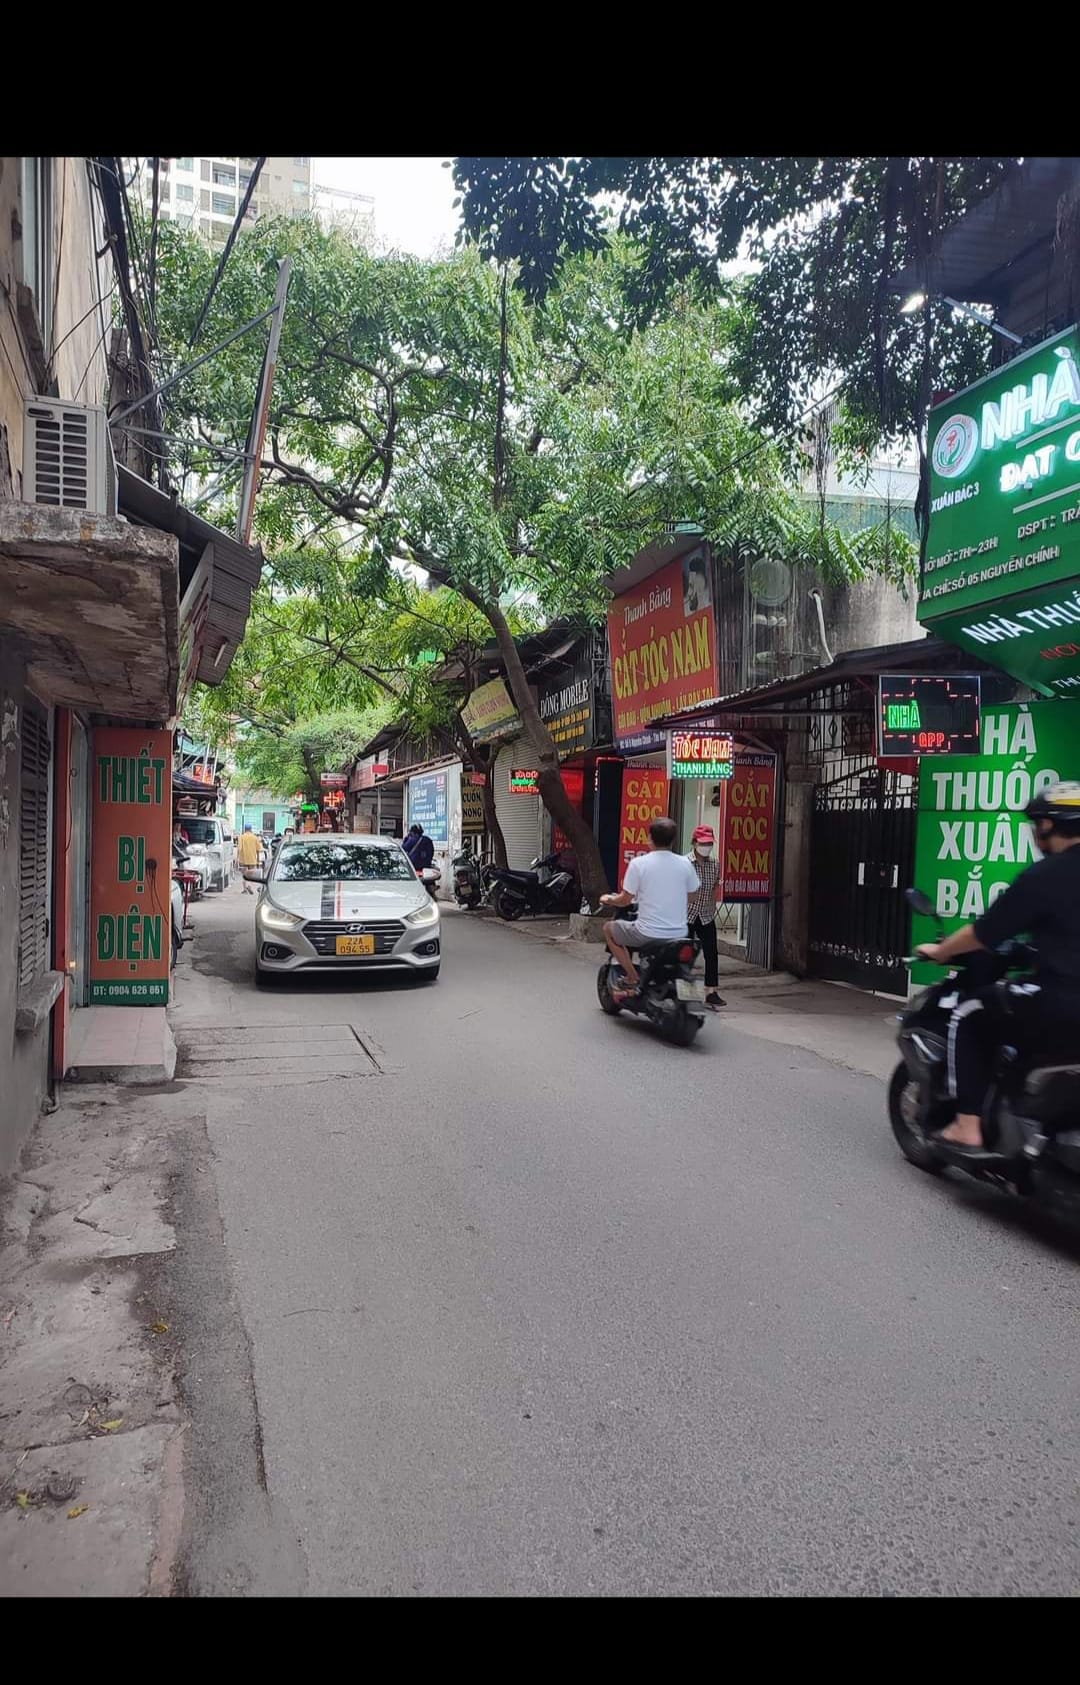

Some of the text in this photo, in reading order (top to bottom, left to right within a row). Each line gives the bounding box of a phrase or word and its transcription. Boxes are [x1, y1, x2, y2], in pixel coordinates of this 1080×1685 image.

[981, 346, 1080, 450] NHÀ
[1000, 444, 1055, 492] ĐẠT
[1025, 545, 1060, 567] CHÍNH
[961, 613, 1034, 644] NHÀ
[614, 616, 711, 699] CẮT TÓC NAM
[560, 679, 589, 711] MOBILE
[888, 700, 921, 729] NHÀ
[983, 704, 1037, 755] HÀ
[96, 742, 165, 806] THIẾT
[675, 762, 704, 774] THANH
[627, 772, 664, 798] CẮT
[731, 771, 769, 807] CẮT
[622, 827, 650, 845] NA
[731, 810, 768, 840] TÓC
[117, 835, 146, 893] BỊ
[727, 849, 768, 874] NAM
[96, 904, 163, 971] ĐIỆN
